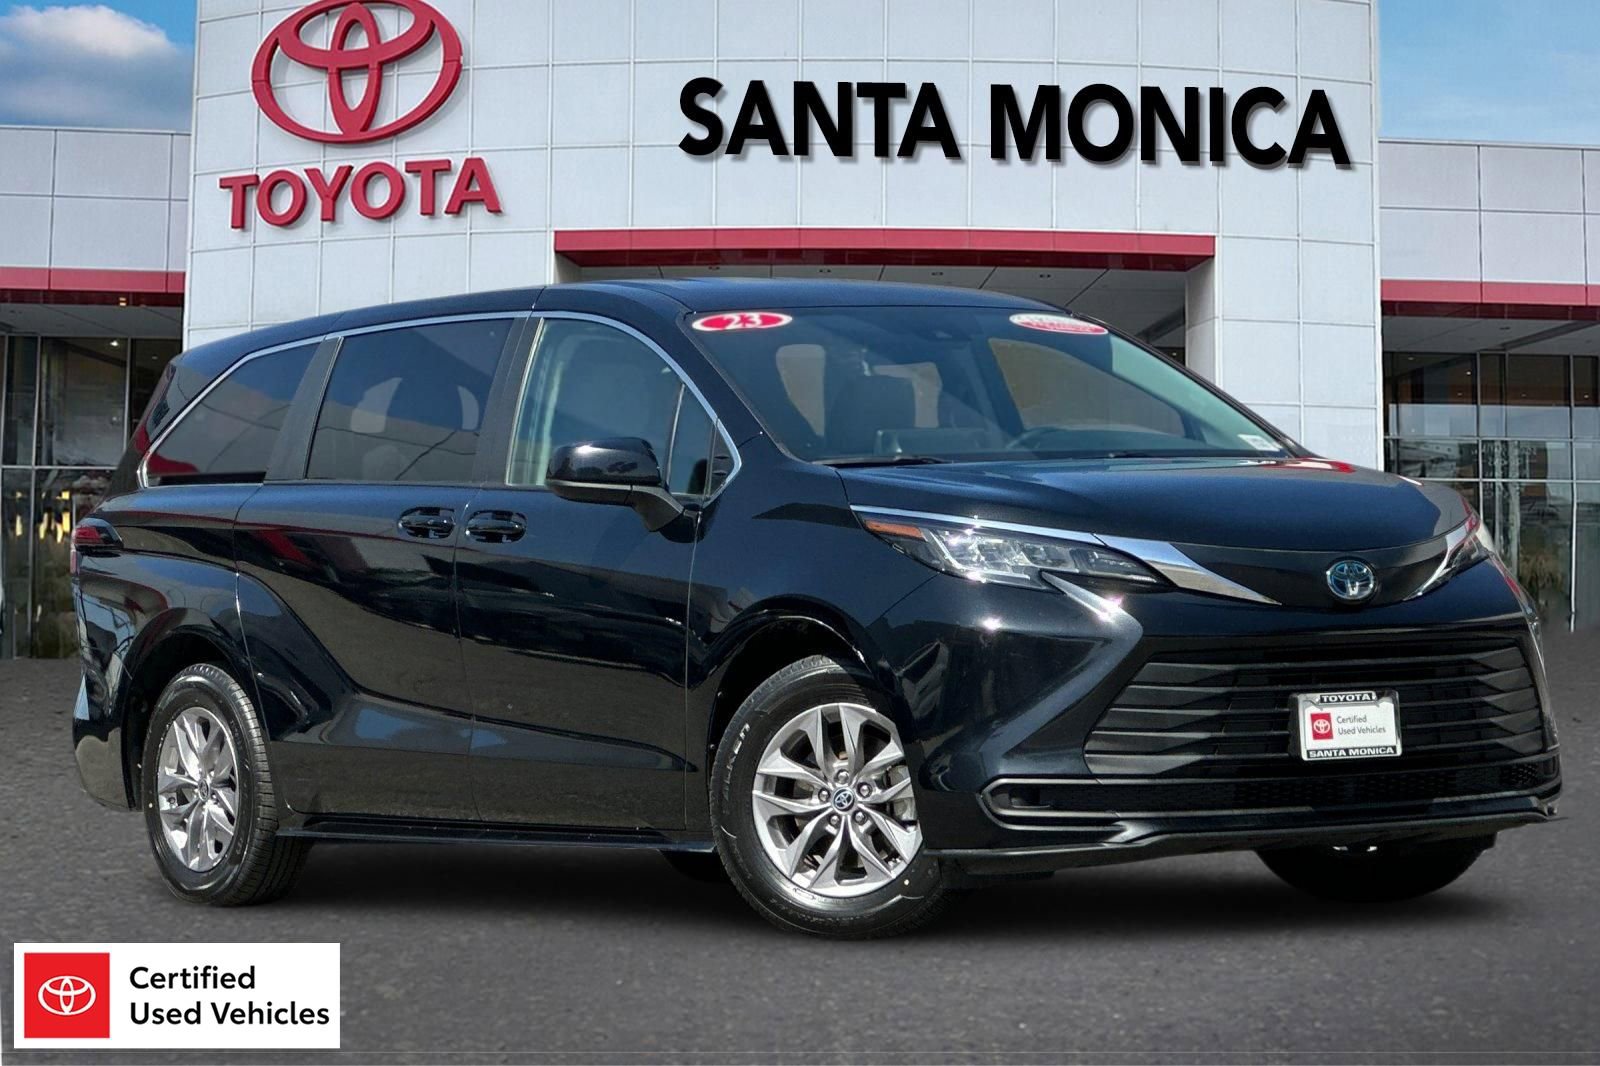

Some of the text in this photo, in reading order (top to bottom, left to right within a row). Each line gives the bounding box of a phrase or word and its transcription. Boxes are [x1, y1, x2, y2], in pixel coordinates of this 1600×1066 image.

[678, 77, 1352, 169] SANTA MONICA
[219, 157, 504, 230] TOYOTA
[719, 313, 762, 329] 23
[1322, 693, 1371, 702] TOYOTA
[1336, 715, 1367, 724] Certified
[1338, 725, 1386, 735] Used Vehicles
[1308, 746, 1394, 758] SANTA MONICA
